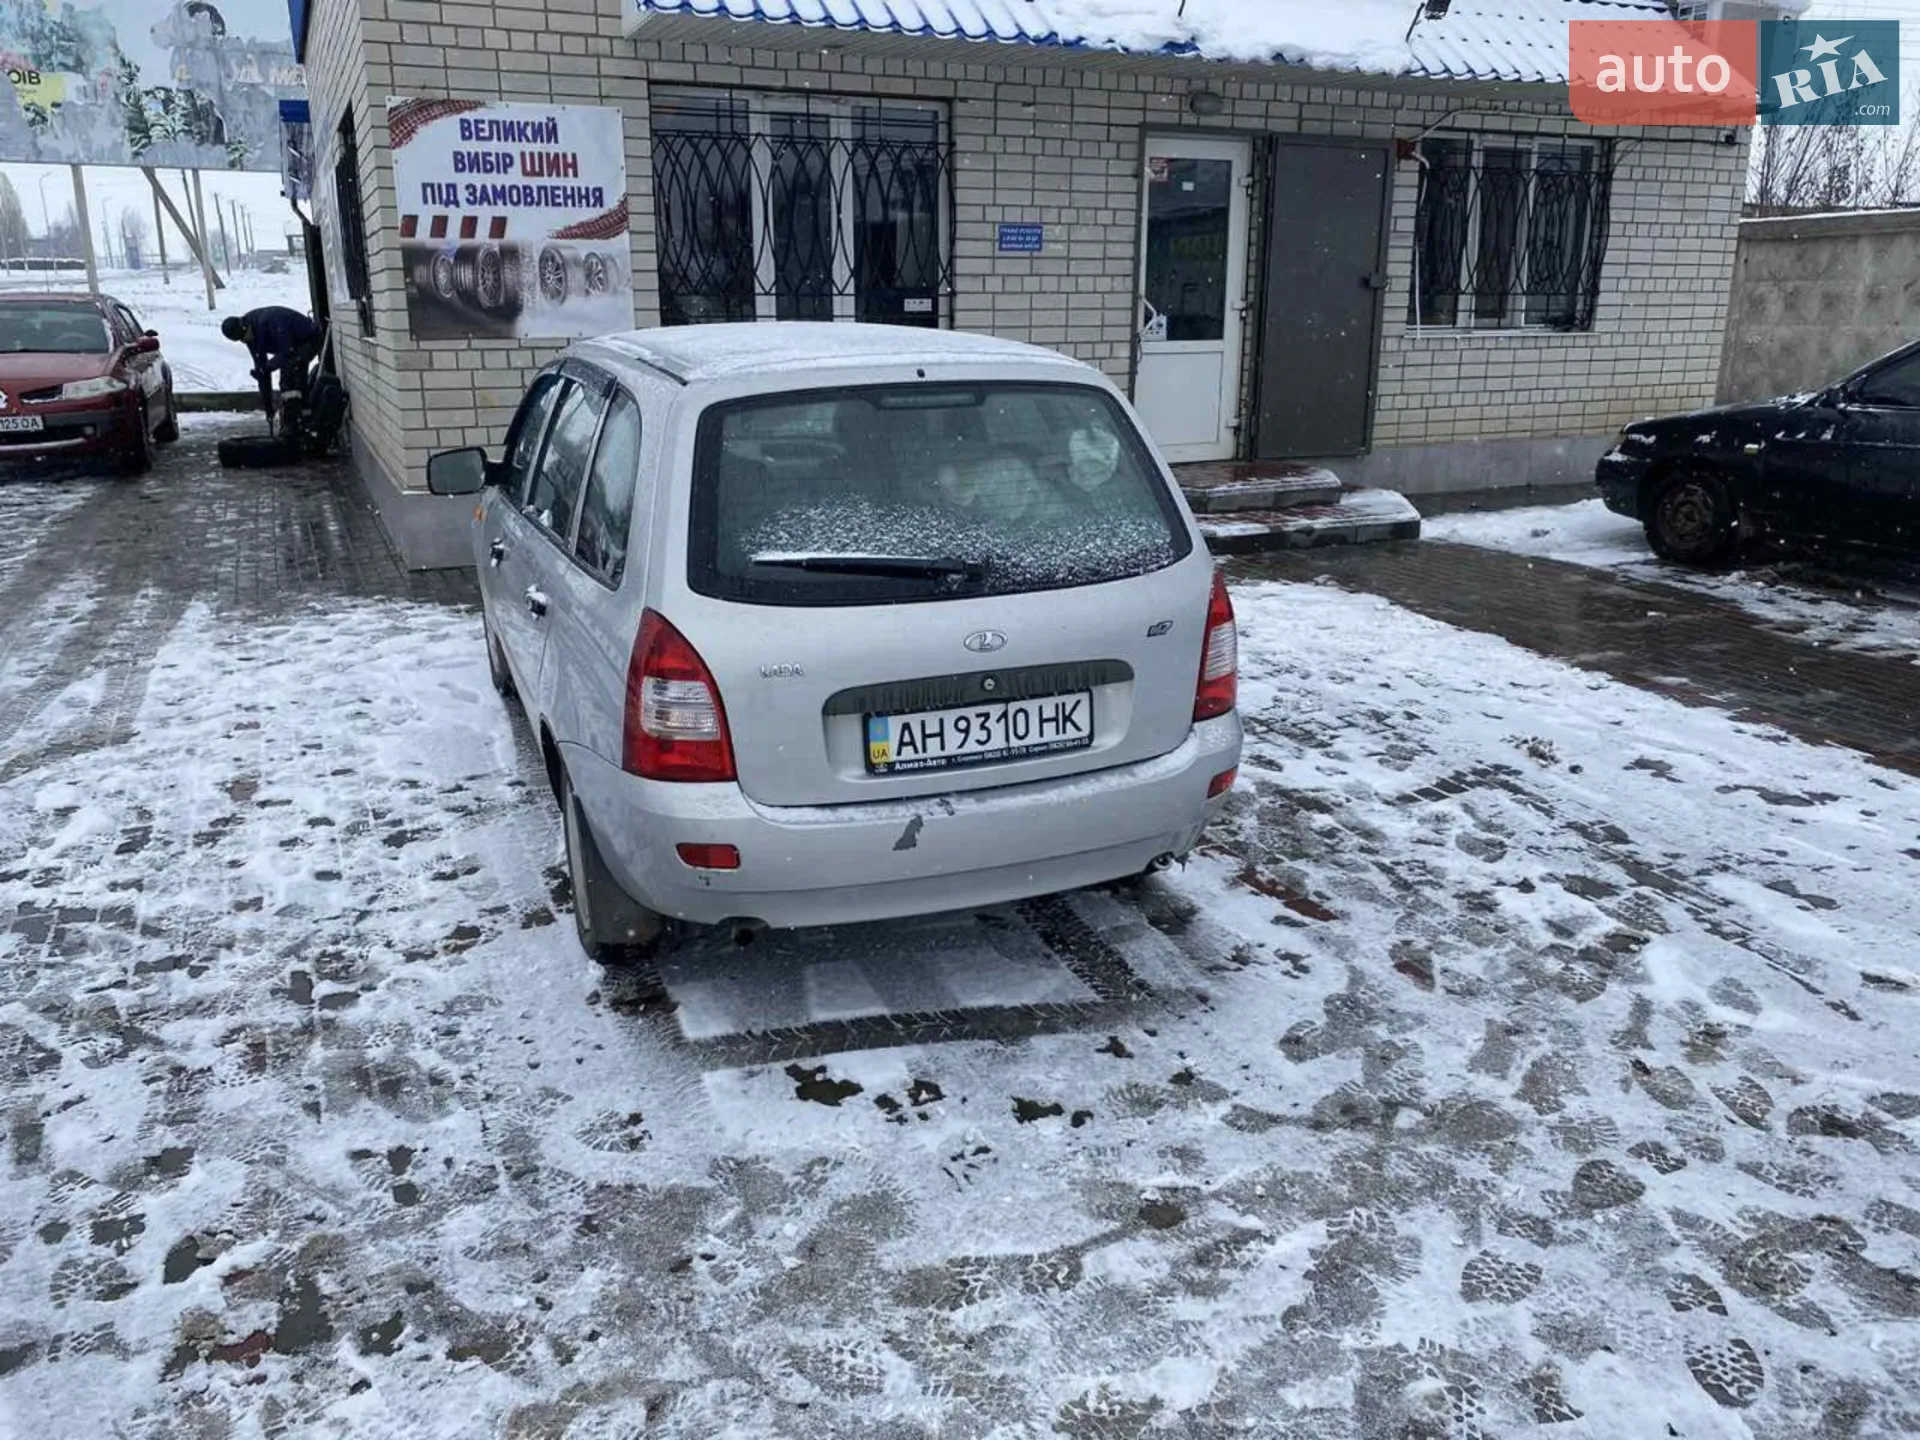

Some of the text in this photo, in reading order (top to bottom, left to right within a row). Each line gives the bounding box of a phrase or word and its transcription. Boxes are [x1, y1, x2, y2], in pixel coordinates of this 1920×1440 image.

[459, 117, 559, 144] ВЕЛИКИЙ
[453, 151, 578, 178] ВИБІР ШИН
[421, 182, 604, 208] ПІД ЗАМОВЛЕННЯ
[896, 699, 1083, 757] AH 9310 HK
[872, 748, 889, 760] UA
